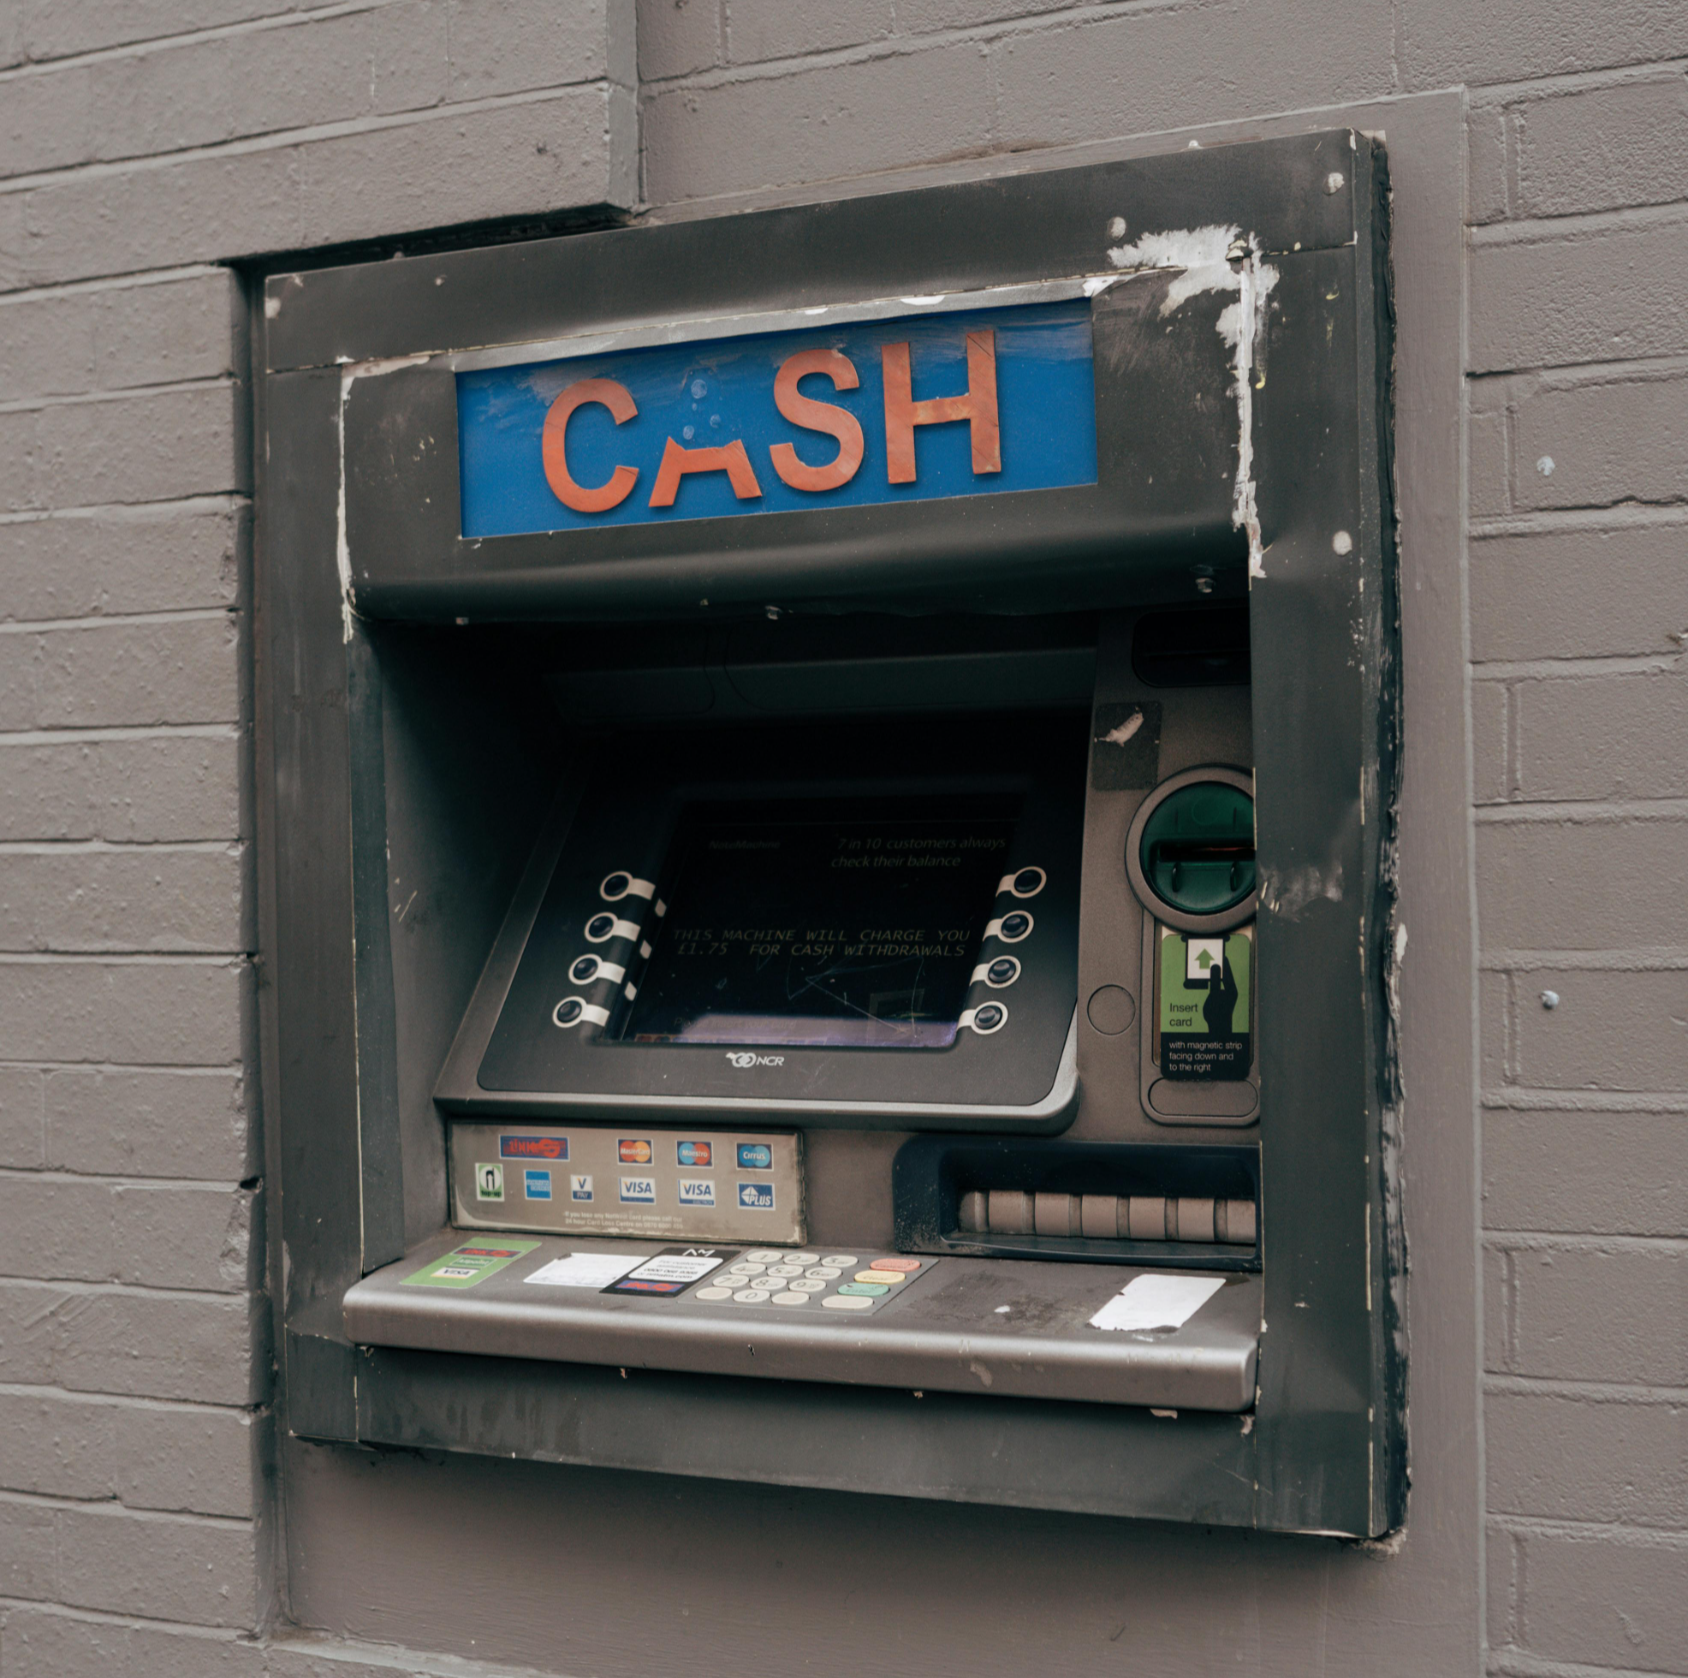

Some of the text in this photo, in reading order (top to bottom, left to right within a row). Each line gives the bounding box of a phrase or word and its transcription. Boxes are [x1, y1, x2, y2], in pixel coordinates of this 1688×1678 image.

[837, 836, 1007, 852] 7 in 10 customers always
[831, 854, 962, 868] check their balance
[673, 929, 971, 942] THIS MACHINE WILL CHARGE YOU
[677, 942, 966, 957] £1.75 FOR CASH WITHDRAWALS
[1169, 1002, 1199, 1013] Insert
[1169, 1016, 1193, 1027] card
[1169, 1041, 1243, 1051] with magnetic strip
[756, 1056, 785, 1066] NCR
[1169, 1052, 1234, 1062] facing down and
[1179, 1063, 1192, 1071] the
[1193, 1063, 1212, 1072] right
[681, 1149, 708, 1158] Maestro
[743, 1151, 766, 1161] Cirrus
[577, 1177, 588, 1189] V
[623, 1181, 653, 1194] VISA
[682, 1182, 712, 1196] VISA
[749, 1195, 772, 1207] PLUS
